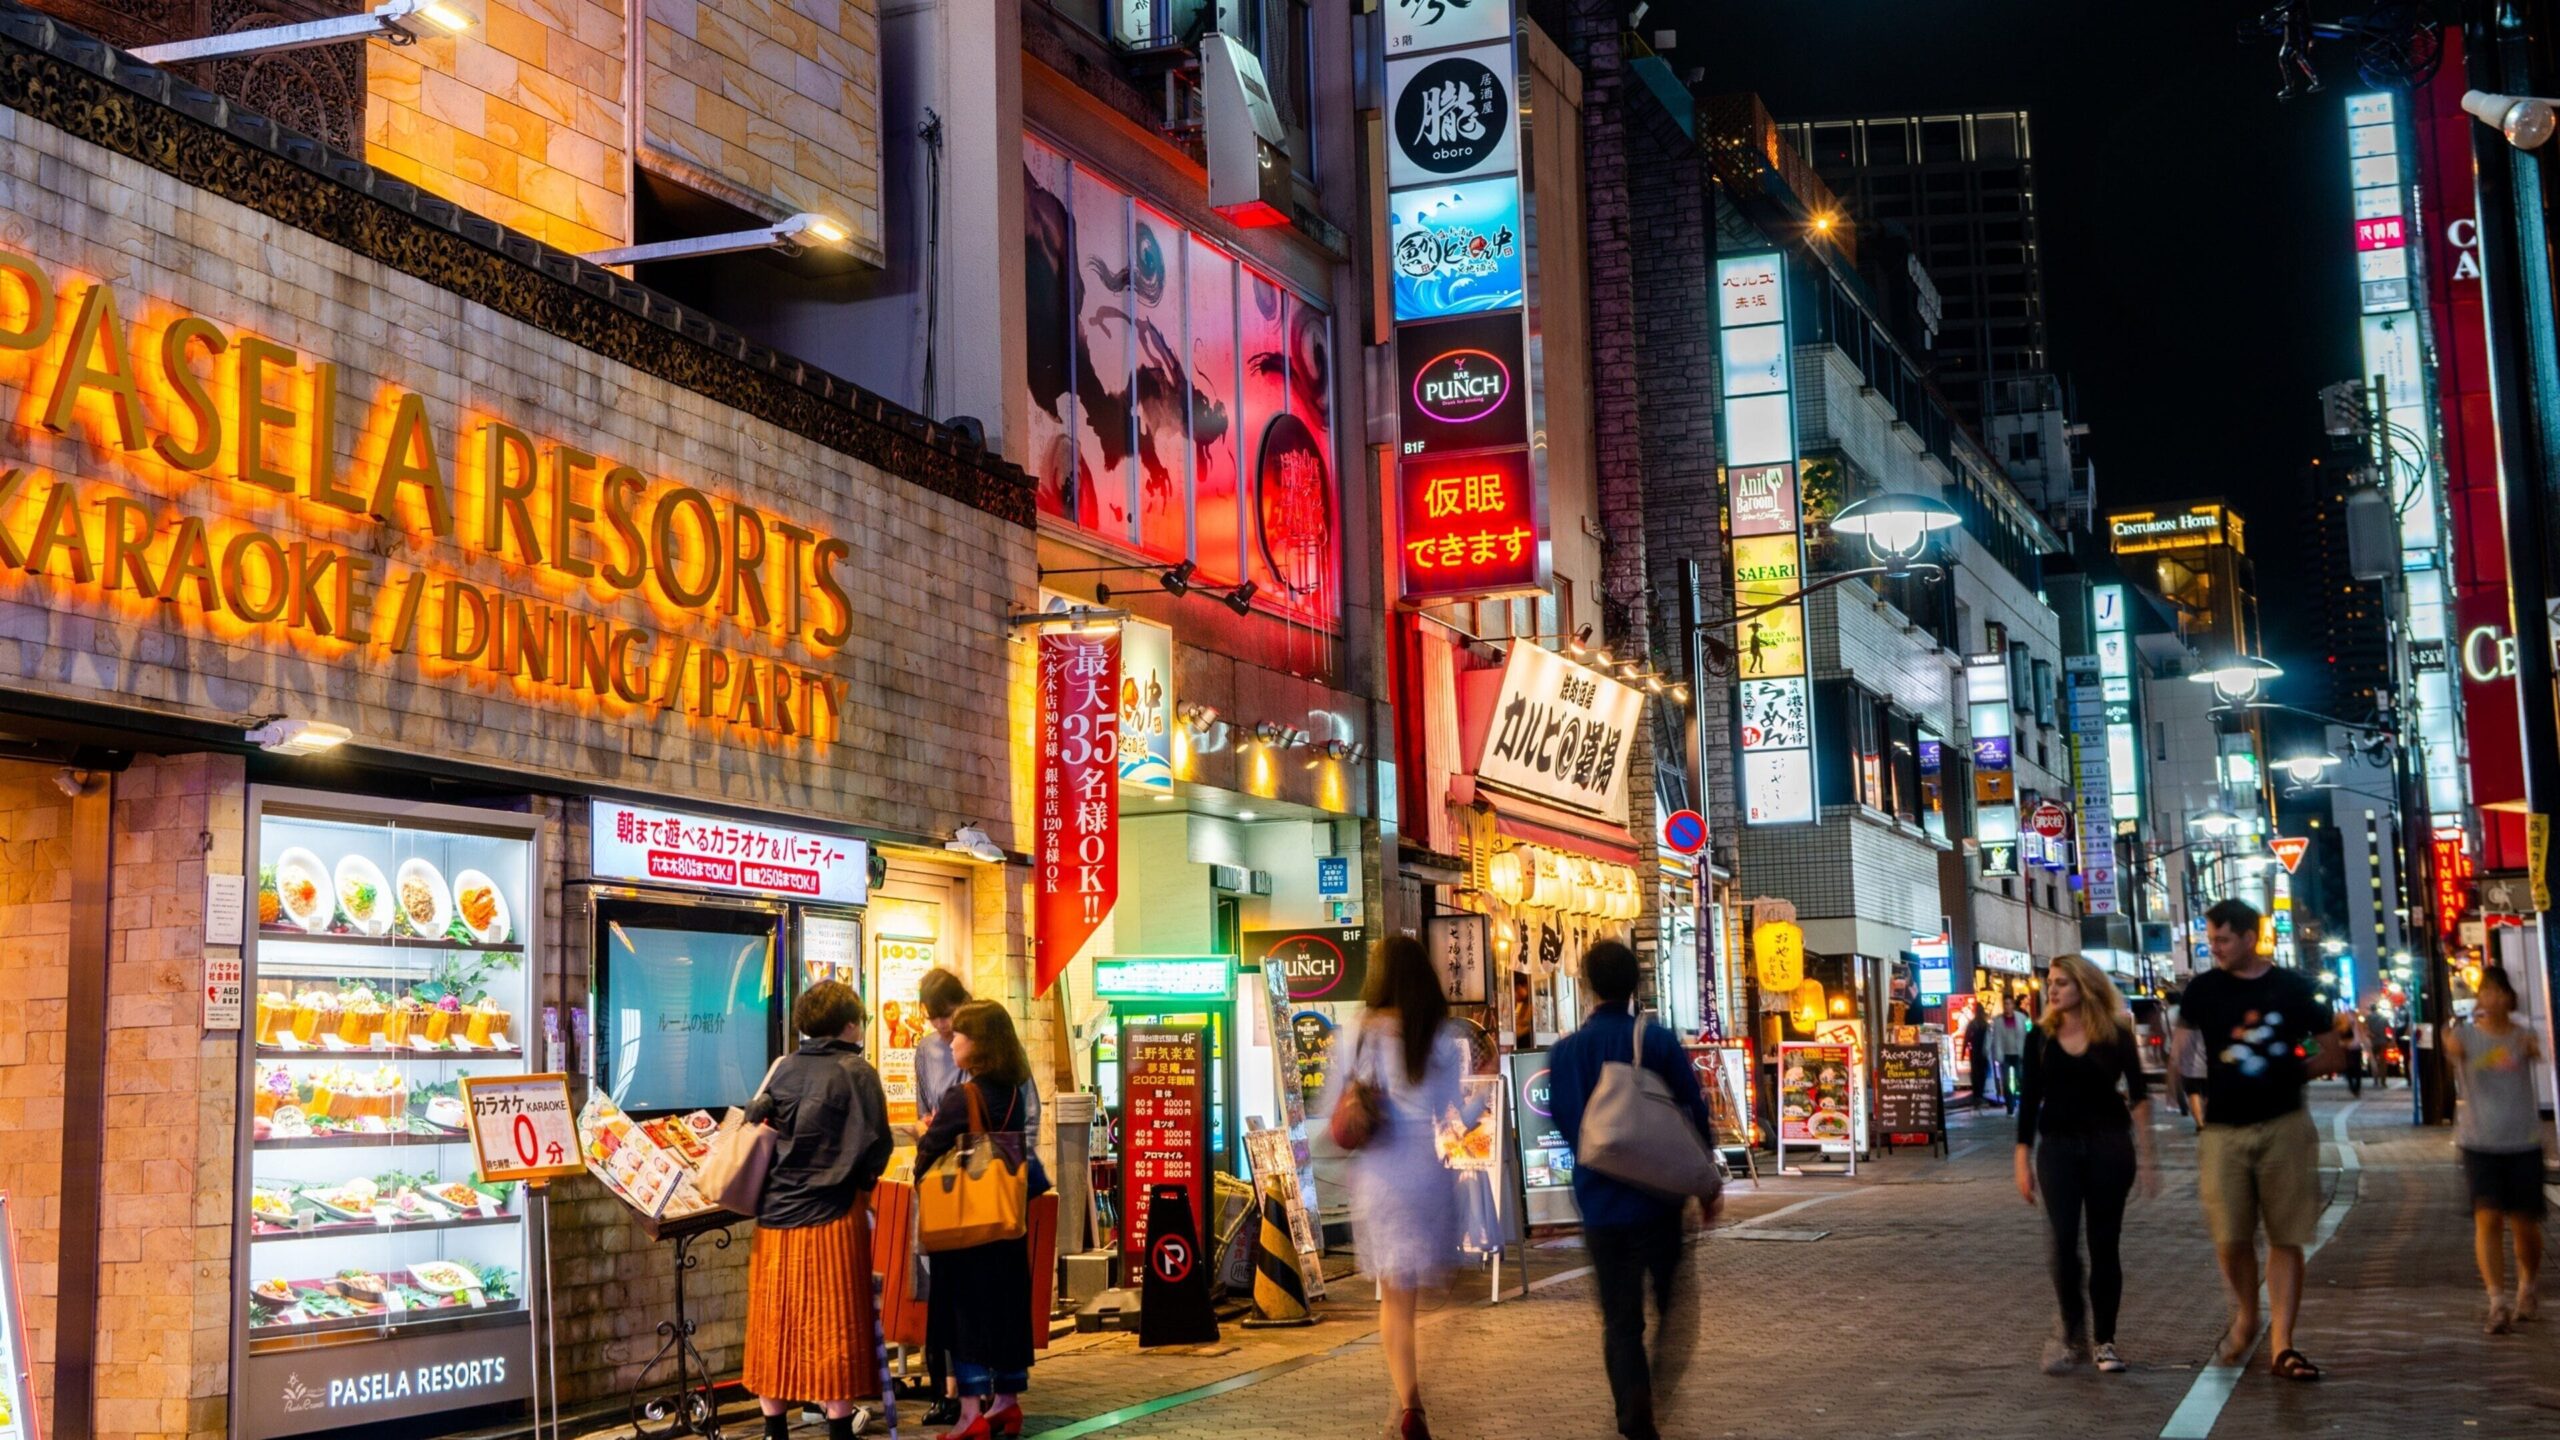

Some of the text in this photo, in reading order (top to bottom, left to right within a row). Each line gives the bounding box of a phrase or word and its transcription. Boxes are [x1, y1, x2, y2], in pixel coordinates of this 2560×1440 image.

[1480, 73, 1494, 114] 居酒屋
[1414, 80, 1486, 146] 朧
[1432, 146, 1473, 160] oboro
[1723, 272, 1775, 287] ベルズ
[1735, 294, 1768, 309] 赤坂
[1453, 371, 1469, 379] BAR
[1426, 375, 1499, 401] PUNCH
[0, 252, 853, 648] PASELA RESORTS
[1404, 441, 1425, 454] B1F
[1739, 472, 1768, 496] Anit
[1424, 474, 1505, 518] 仮眠
[1736, 496, 1774, 513] Baroom
[1778, 519, 1792, 530] 3F
[1407, 526, 1531, 568] できます
[1737, 563, 1796, 580] SAFARI
[0, 468, 374, 644] KARAOKE
[442, 580, 650, 703] DINING
[699, 647, 850, 743] PARTY
[2100, 593, 2116, 619] J
[1758, 681, 1788, 747] らーめん
[1042, 647, 1062, 893] 六本木店80名様・銀座店120名様OK
[1062, 644, 1117, 924] 最大35名様OK!!
[2035, 815, 2063, 828] 消火栓
[1343, 931, 1361, 941] B1F
[1284, 959, 1335, 976] UNCH
[223, 987, 239, 995] AED
[658, 1012, 725, 1034] ルームの紹介
[1181, 1033, 1195, 1044] 4F
[1132, 1046, 1196, 1060] 上野気楽堂
[474, 1095, 567, 1116] カラオケ KARAOKE
[514, 1114, 564, 1167] 0 分
[1144, 1151, 1183, 1159] アロマオイル
[329, 1356, 505, 1407] PASELA RESORTS
